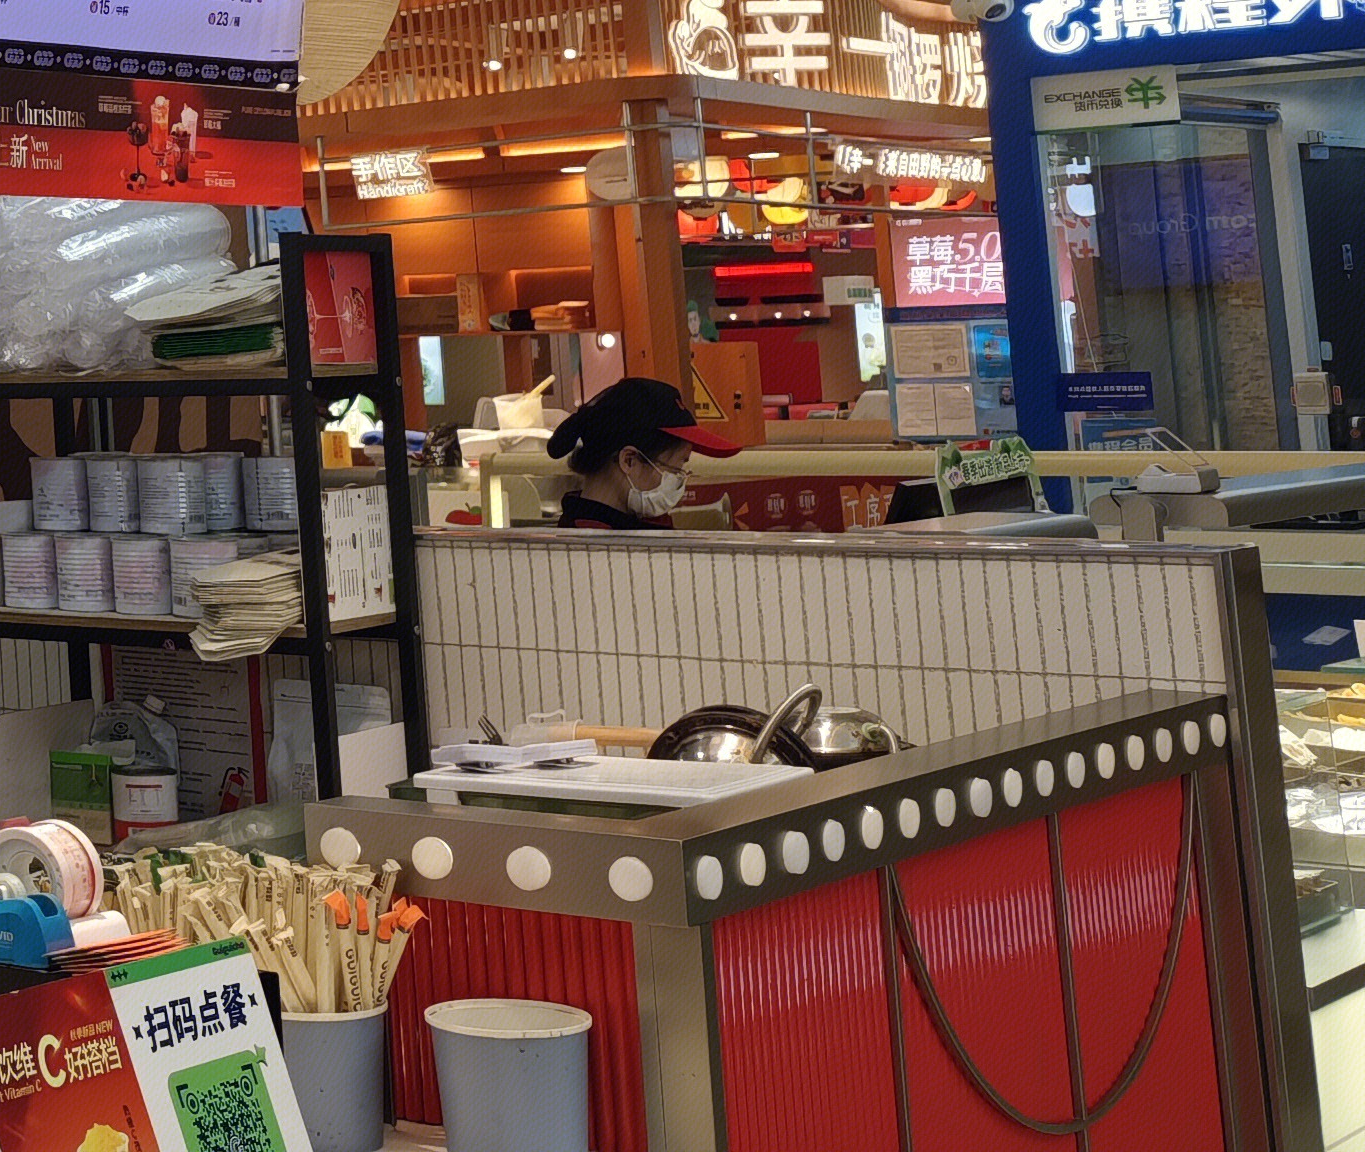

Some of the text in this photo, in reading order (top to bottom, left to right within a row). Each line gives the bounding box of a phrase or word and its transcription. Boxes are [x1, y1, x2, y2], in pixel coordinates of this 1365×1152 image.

[1044, 87, 1122, 104] EXCHANGE
[1074, 98, 1123, 112] 货币兑换
[16, 98, 86, 129] Christmas
[30, 135, 50, 152] New
[30, 153, 63, 171] Arrival
[351, 151, 423, 182] 手作区
[358, 180, 426, 200] Handicraft
[96, 1018, 114, 1035] NEW
[144, 982, 248, 1053] 扫码点餐
[64, 1034, 123, 1084] 好搭档
[4, 1084, 34, 1101] Vitamin
[33, 1080, 43, 1092] C
